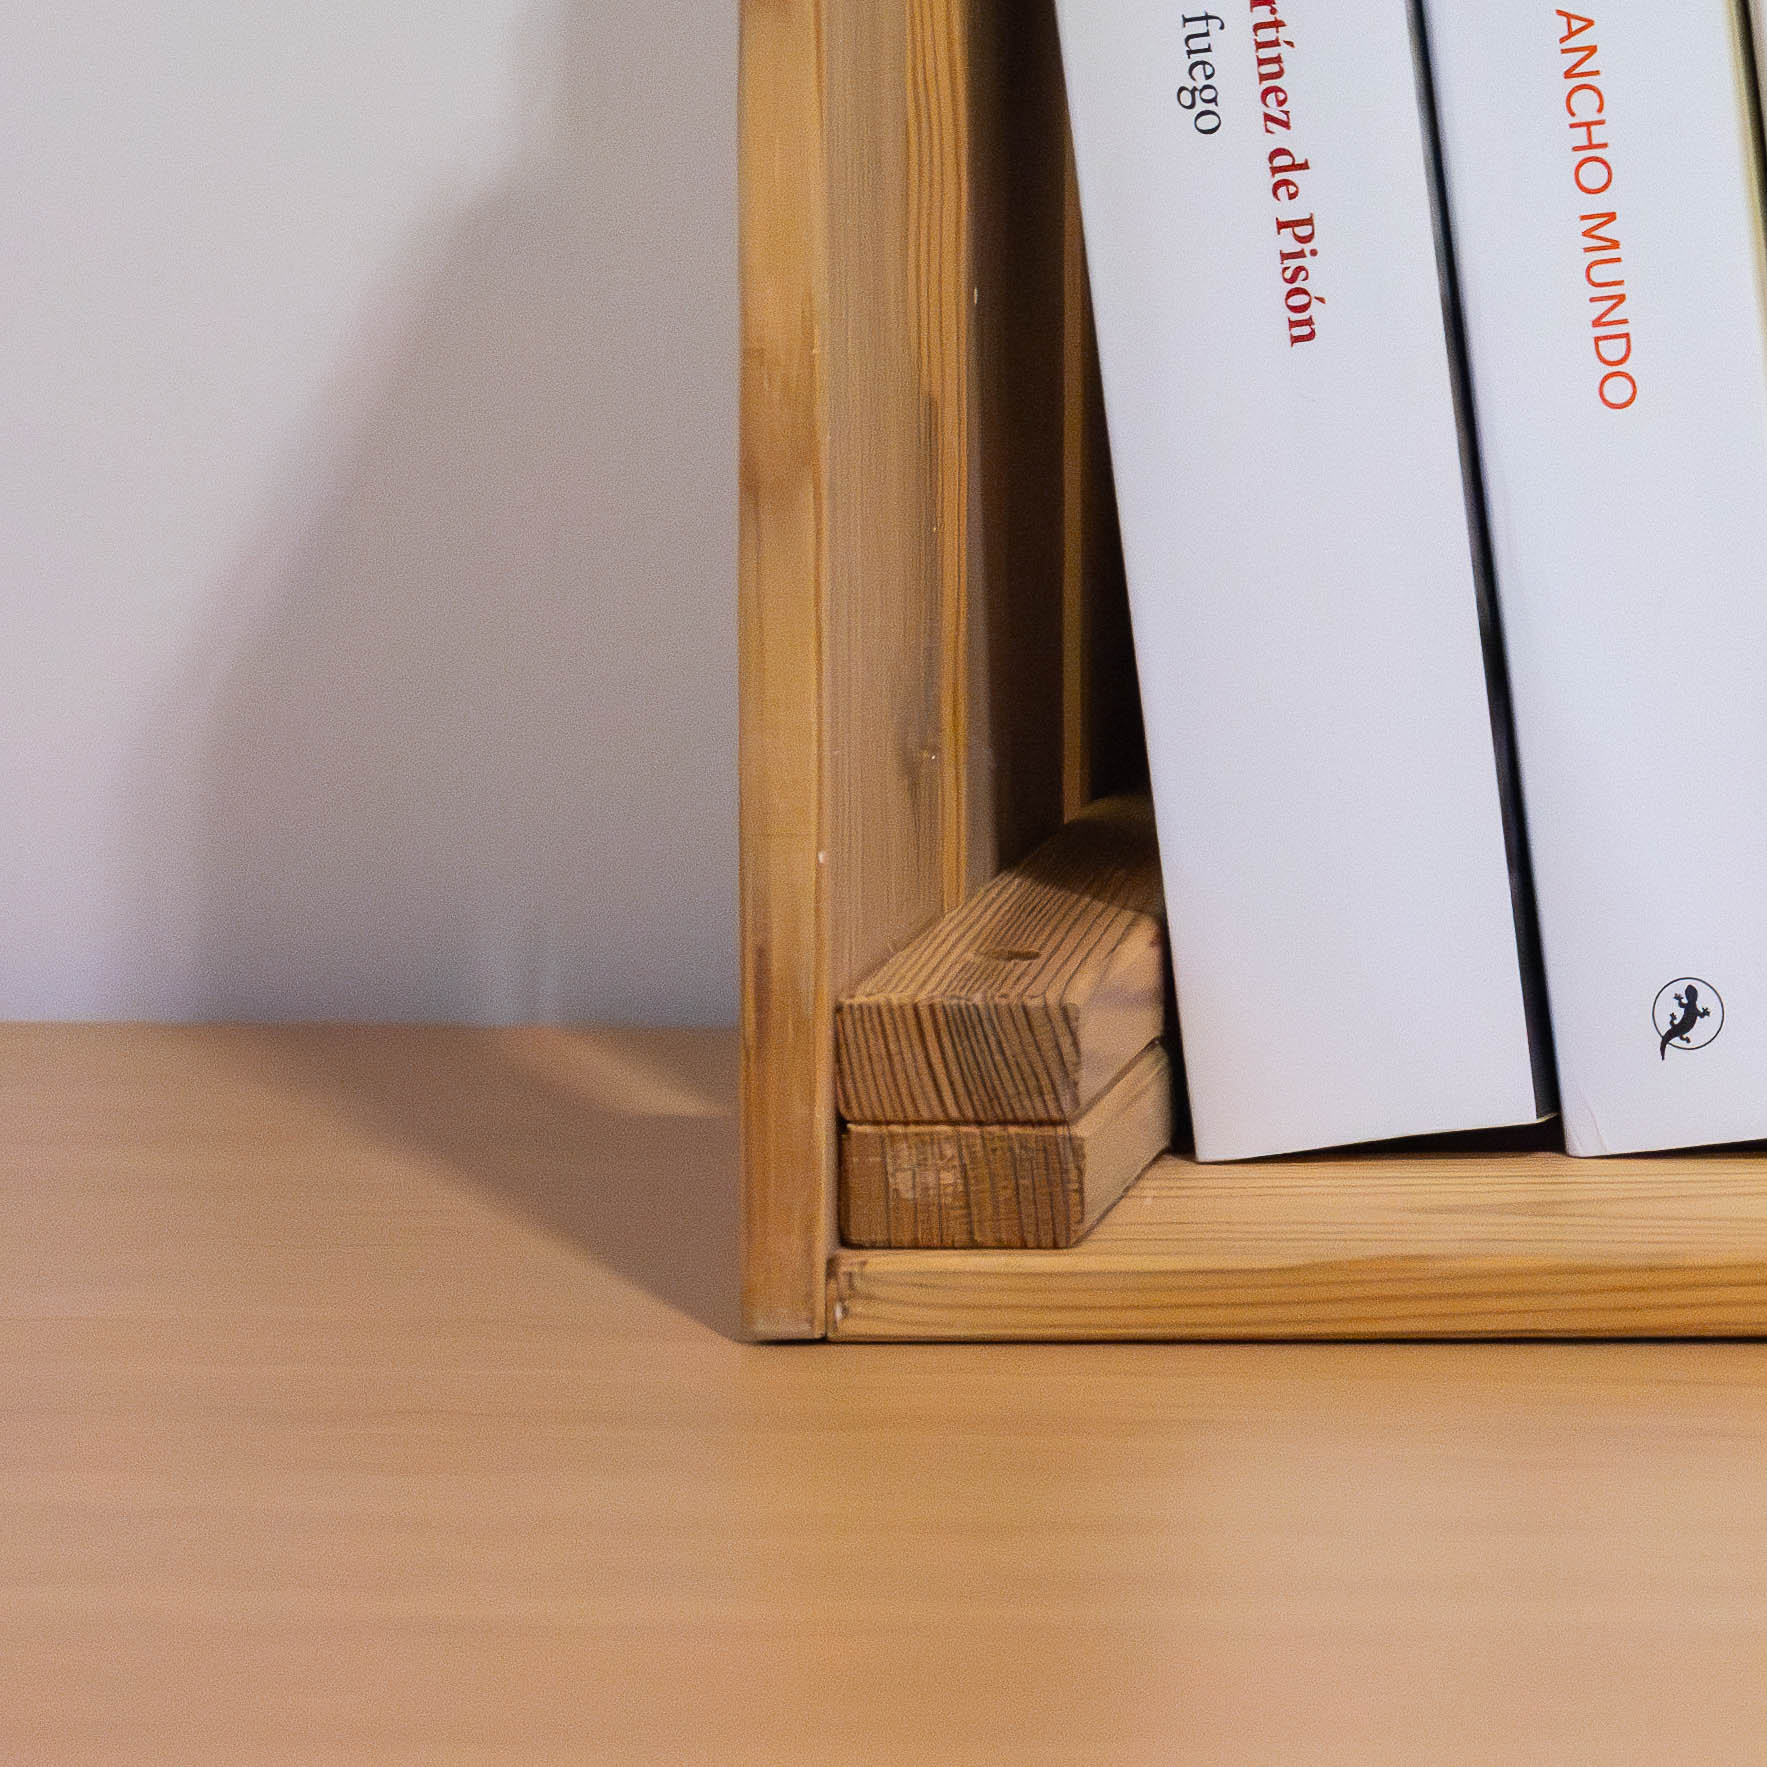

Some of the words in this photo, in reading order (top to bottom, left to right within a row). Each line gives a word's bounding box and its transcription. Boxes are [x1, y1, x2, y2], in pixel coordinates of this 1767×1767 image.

[1176, 11, 1225, 135] fuego
[1555, 9, 1613, 195] ANCHO
[1268, 147, 1310, 201] de
[1275, 213, 1327, 347] Pisón
[1578, 211, 1638, 410] MUNDO
